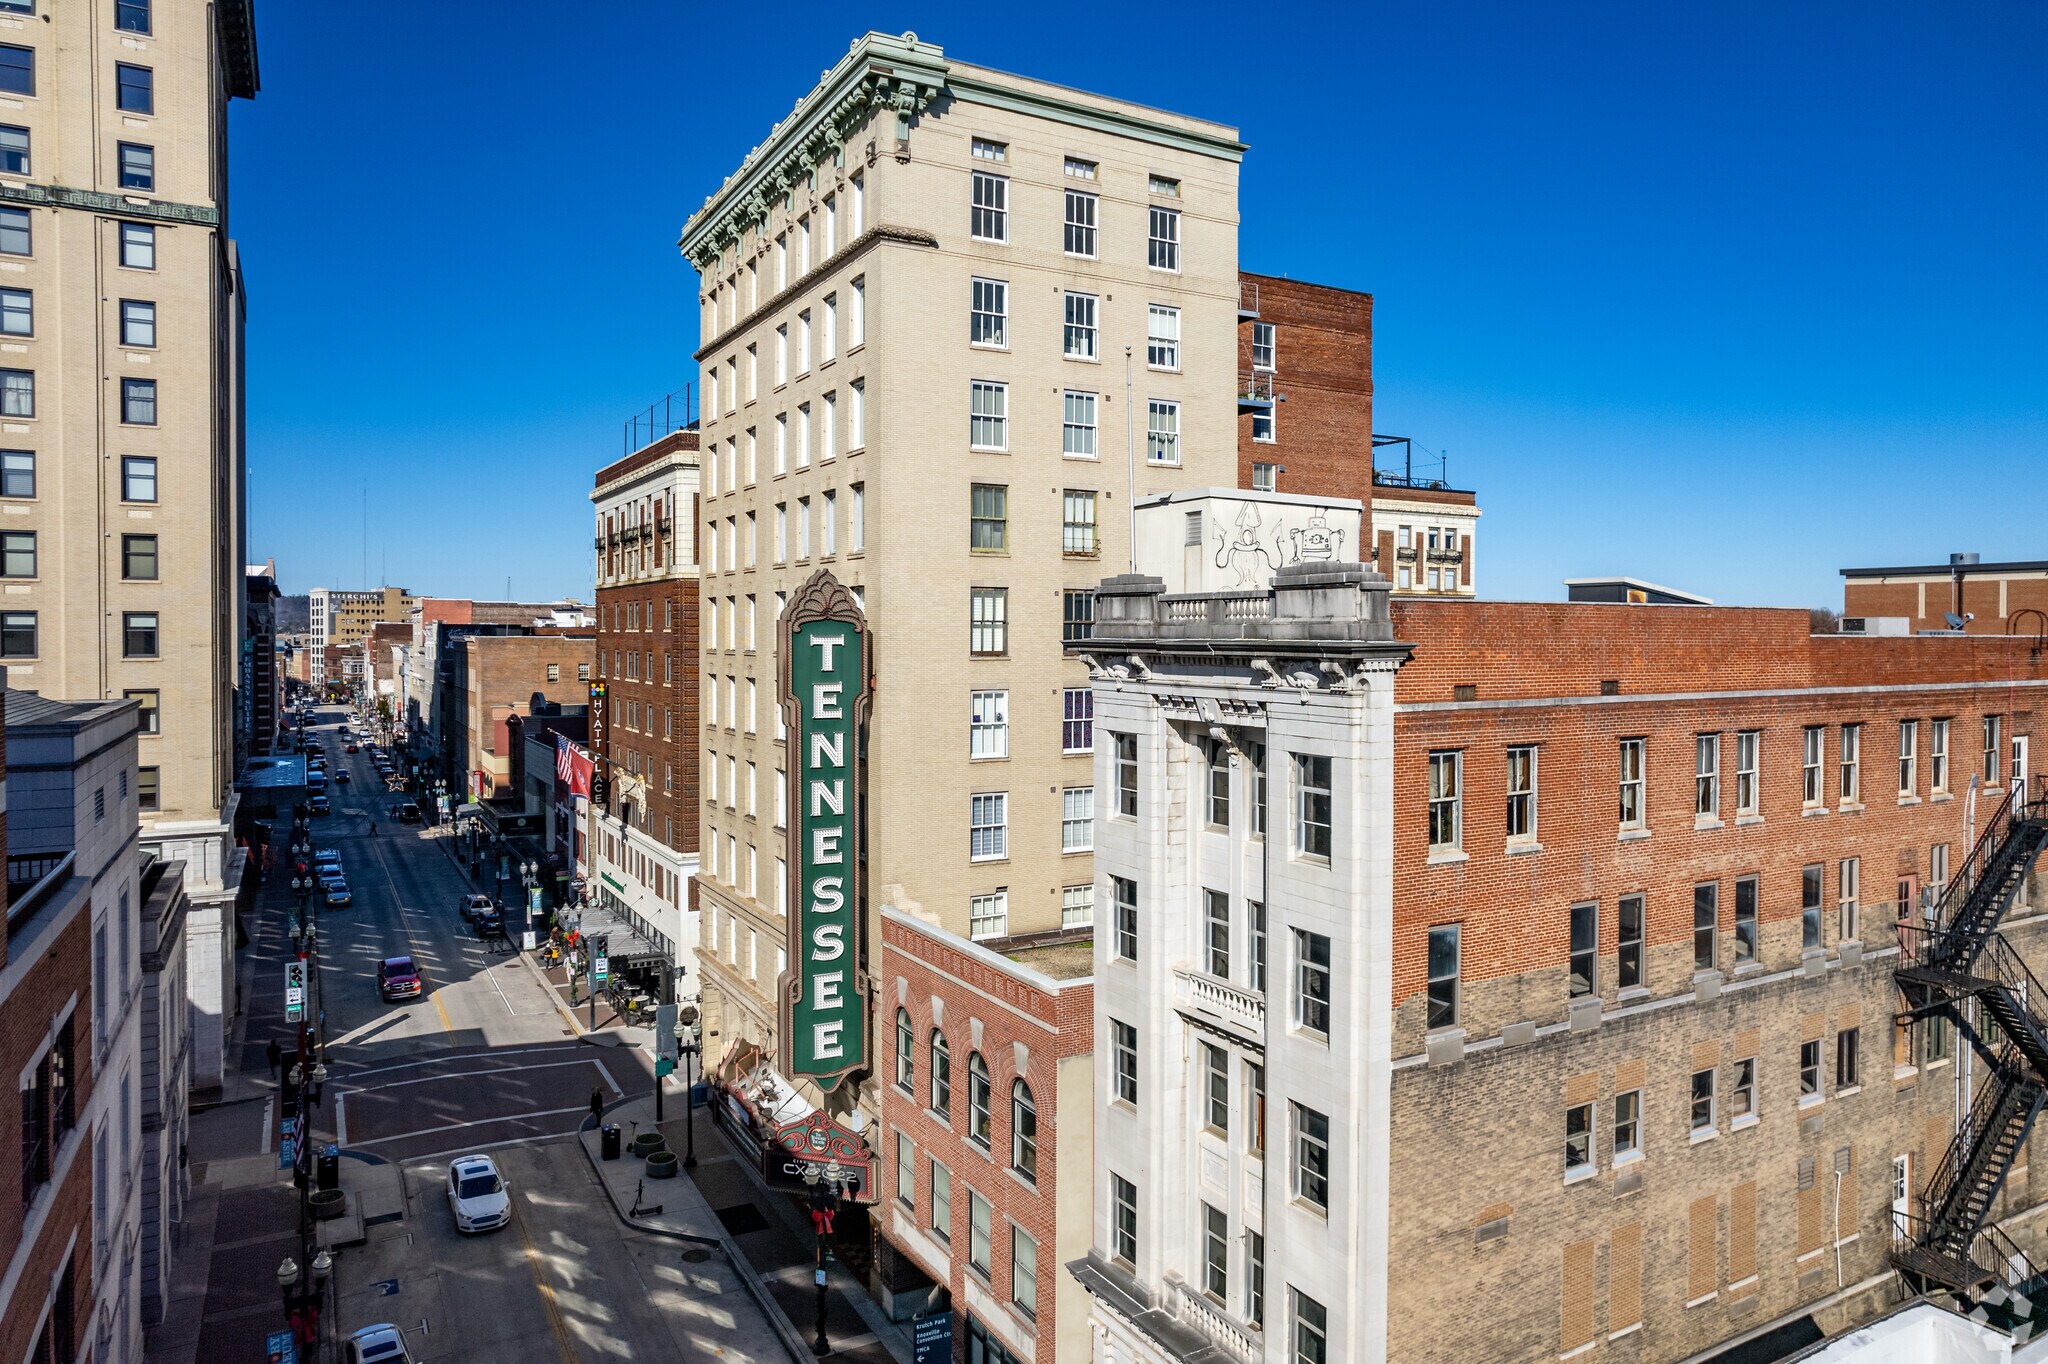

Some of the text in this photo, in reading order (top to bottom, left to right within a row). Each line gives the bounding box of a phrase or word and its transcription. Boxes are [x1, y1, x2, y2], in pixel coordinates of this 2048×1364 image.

[244, 656, 252, 734] EMBASSY SUITES
[594, 699, 602, 748] HYATT
[809, 633, 845, 1060] TENNESSEE
[916, 1321, 933, 1329] Krutch
[916, 1329, 940, 1338] Knoxville
[916, 1334, 943, 1344] Convention
